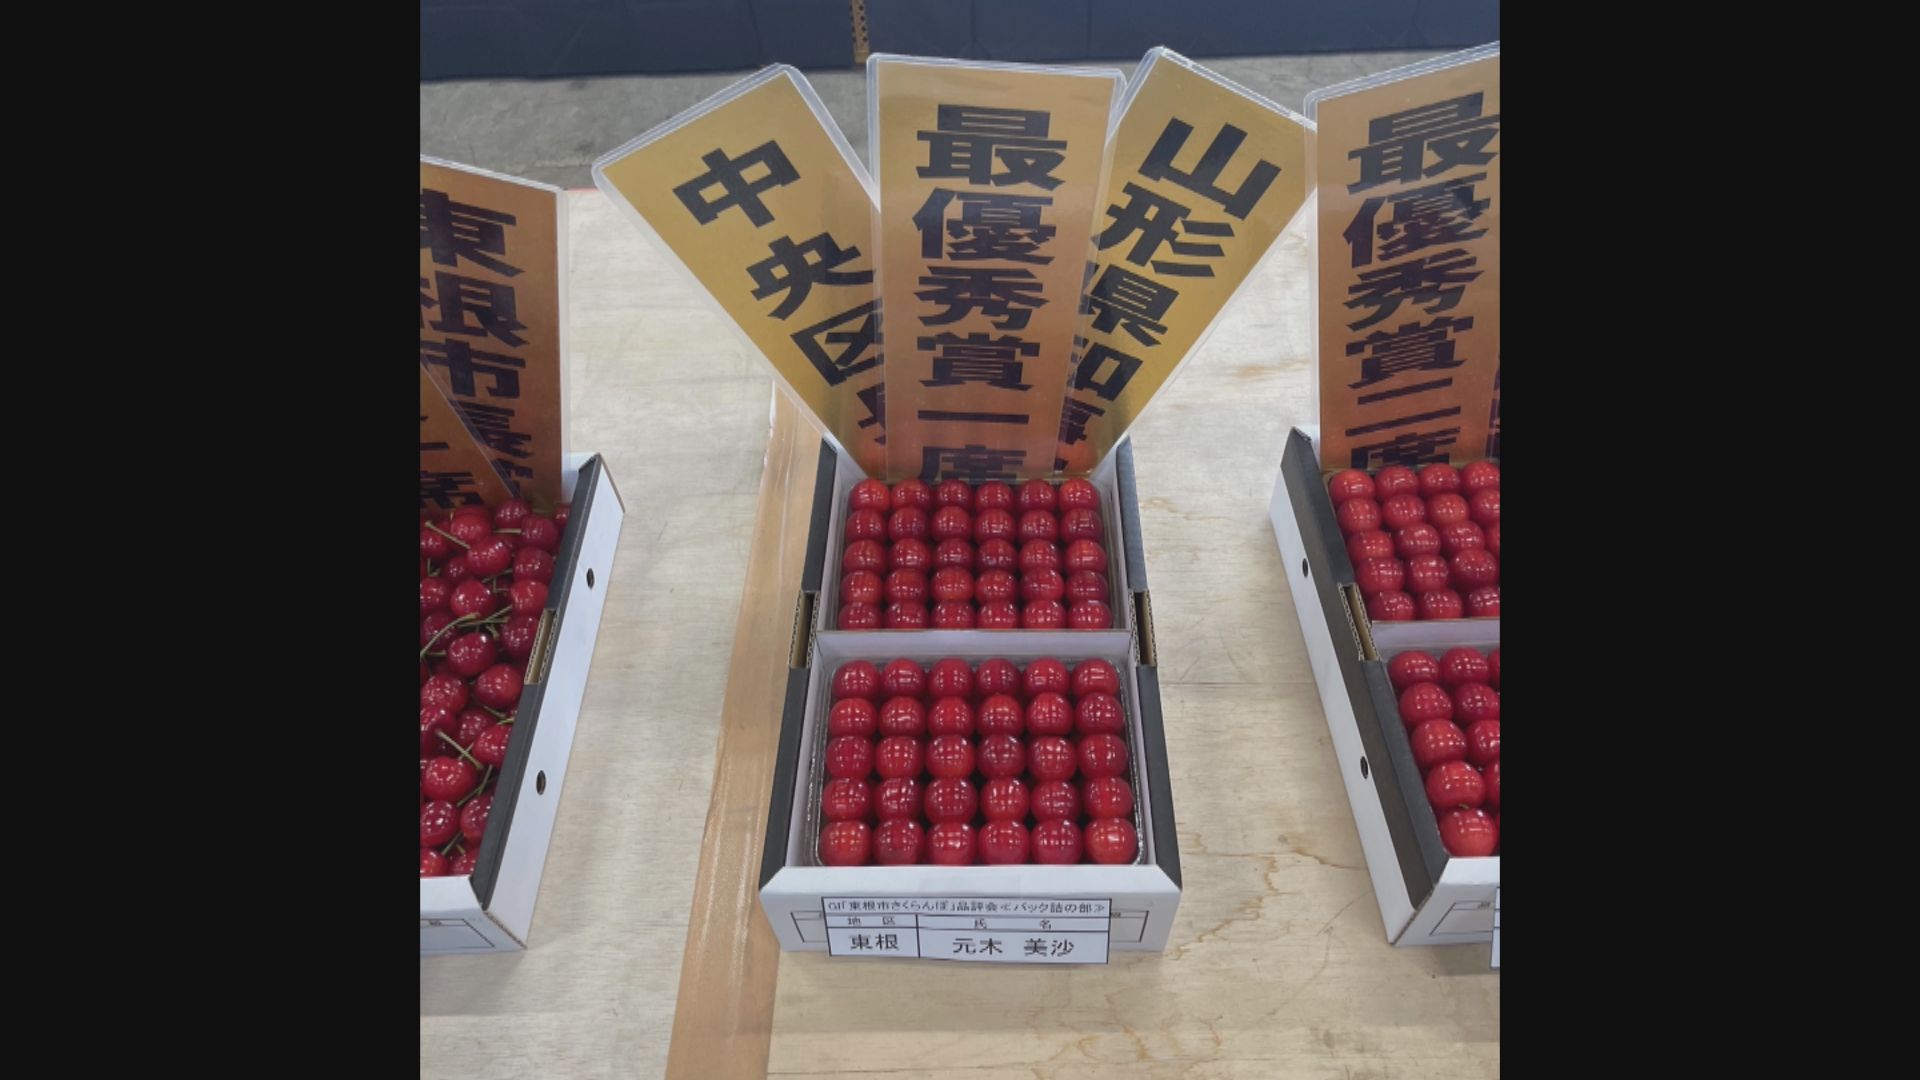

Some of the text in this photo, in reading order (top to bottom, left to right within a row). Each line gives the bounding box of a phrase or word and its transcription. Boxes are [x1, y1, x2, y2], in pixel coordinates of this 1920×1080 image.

[420, 188, 535, 500] 東根市長
[912, 104, 1067, 483] 最優秀賞一席
[850, 933, 899, 951] 東根
[953, 937, 1074, 957] 元木 美沙
